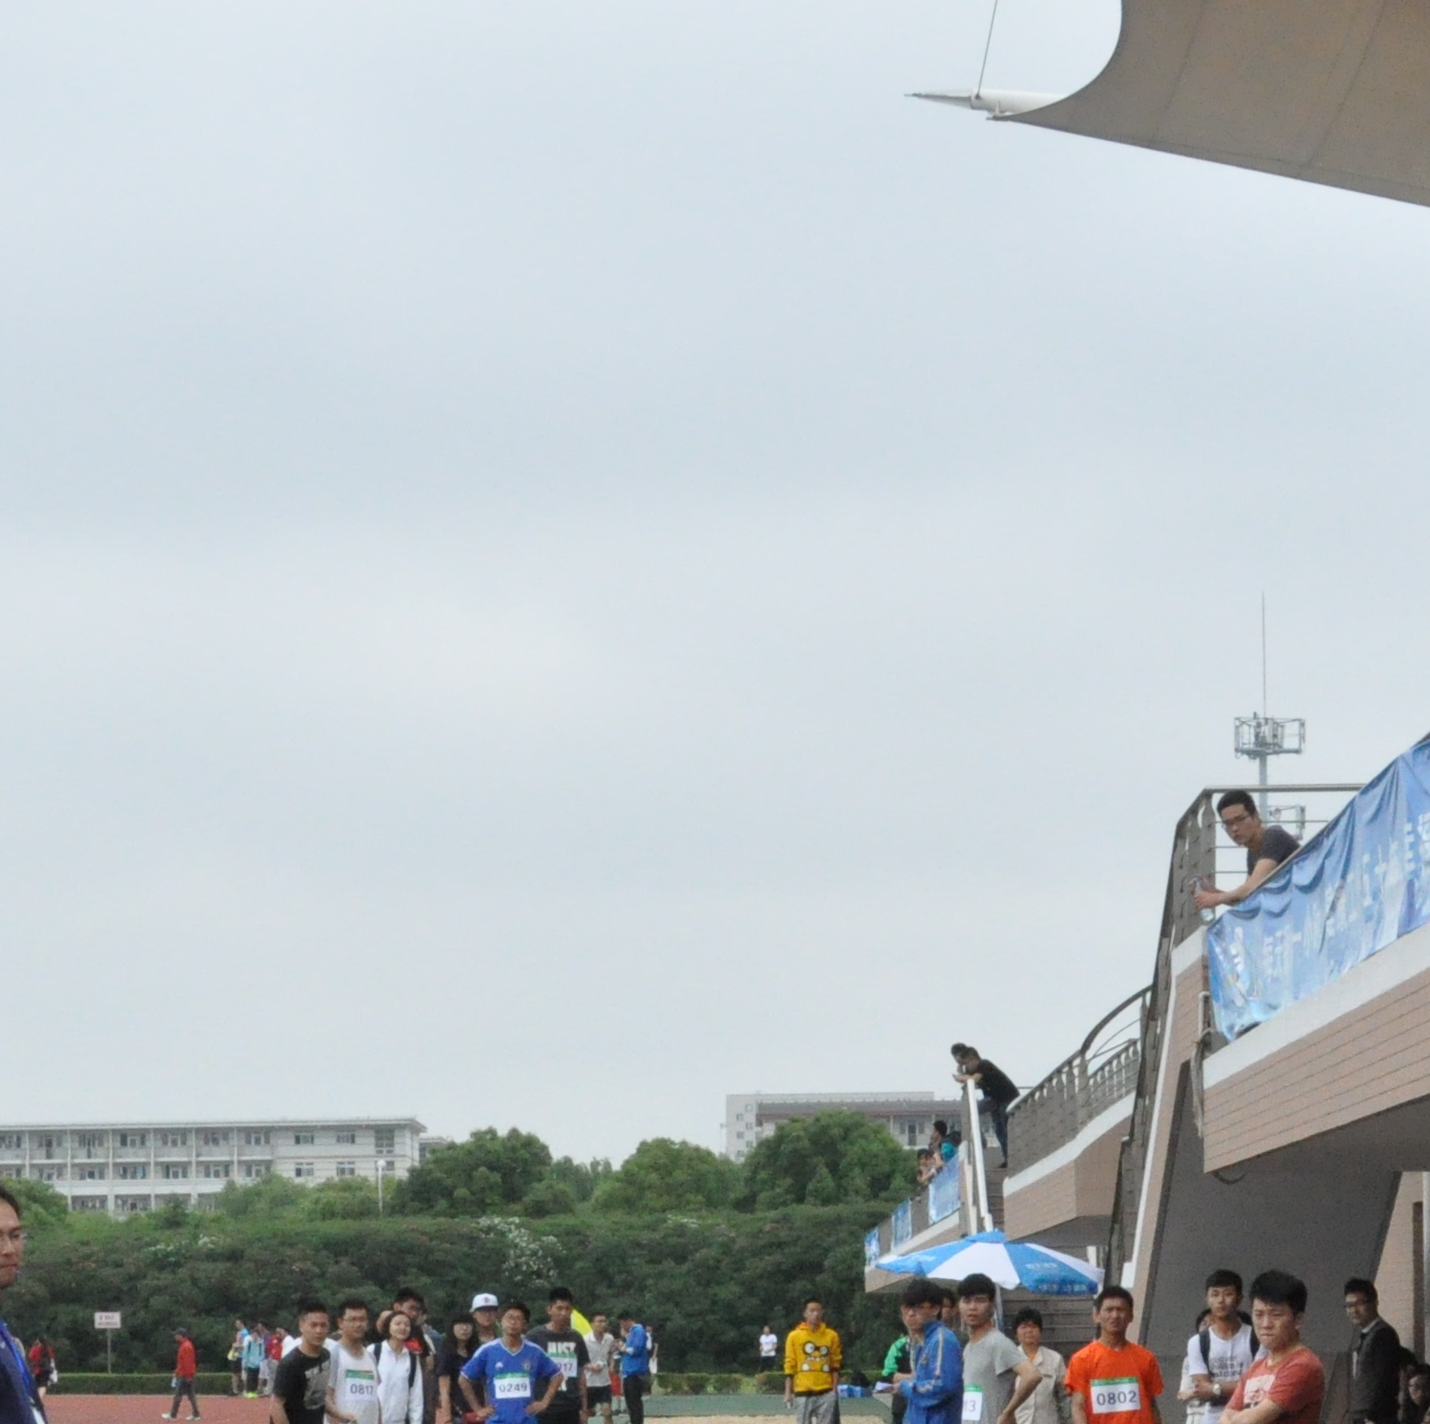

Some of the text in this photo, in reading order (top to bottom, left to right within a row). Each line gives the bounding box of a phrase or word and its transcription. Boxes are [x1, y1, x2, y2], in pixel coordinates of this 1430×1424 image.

[350, 1384, 374, 1394] 0817
[499, 1382, 528, 1393] 0249
[1096, 1390, 1137, 1406] 0802
